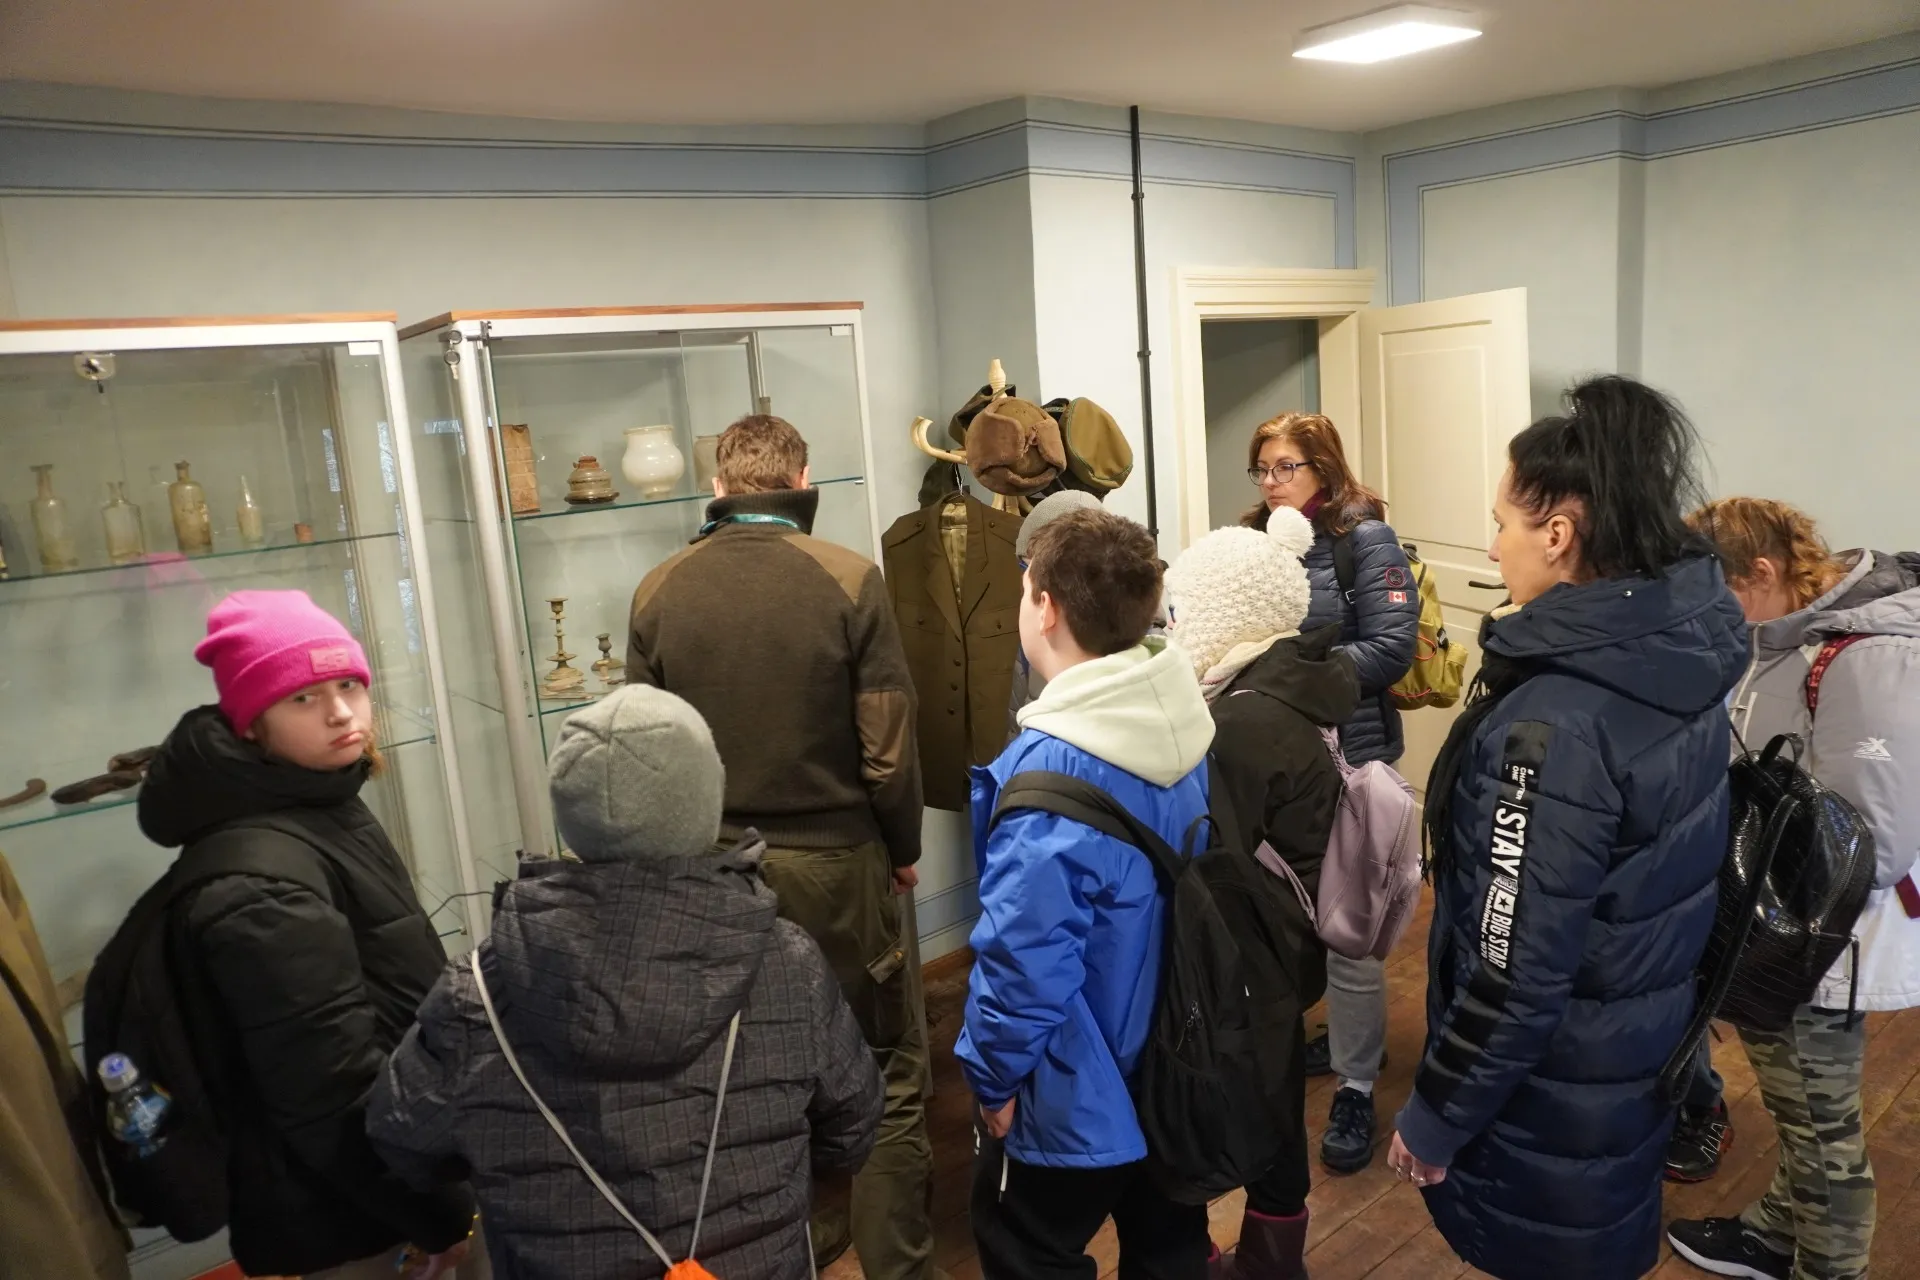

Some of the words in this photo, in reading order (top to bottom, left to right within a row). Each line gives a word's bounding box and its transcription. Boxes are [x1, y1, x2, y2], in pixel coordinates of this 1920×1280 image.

[1511, 765, 1519, 781] ONE
[1514, 767, 1526, 800] CHAPTER
[1491, 808, 1526, 877] STAY
[1481, 885, 1497, 934] Established
[1490, 912, 1512, 937] BIG
[1487, 934, 1509, 969] STAR
